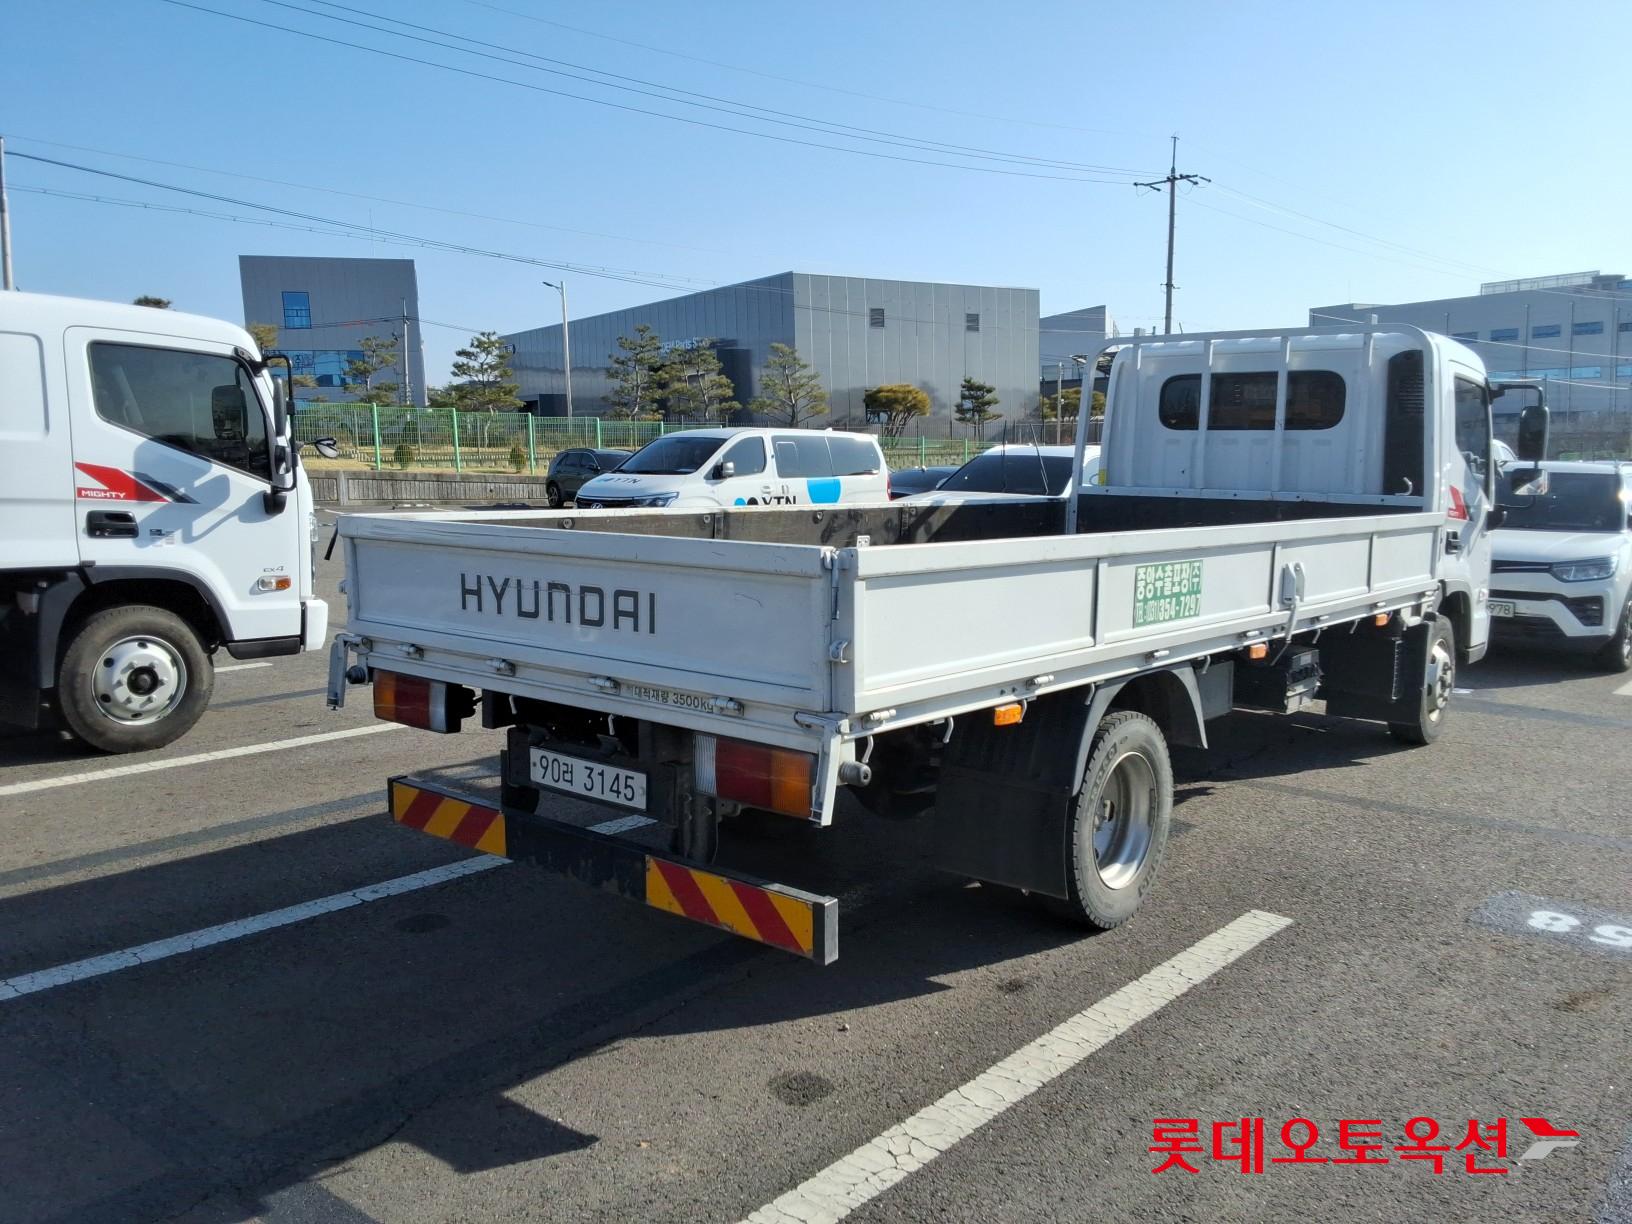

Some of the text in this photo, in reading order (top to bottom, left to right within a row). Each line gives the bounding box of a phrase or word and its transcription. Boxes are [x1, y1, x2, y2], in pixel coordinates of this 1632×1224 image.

[81, 489, 126, 499] MIGHTY
[460, 572, 656, 635] HYUNDAI
[1488, 602, 1511, 616] 978
[623, 684, 670, 704] 대적재량
[539, 755, 635, 802] 90러 3145
